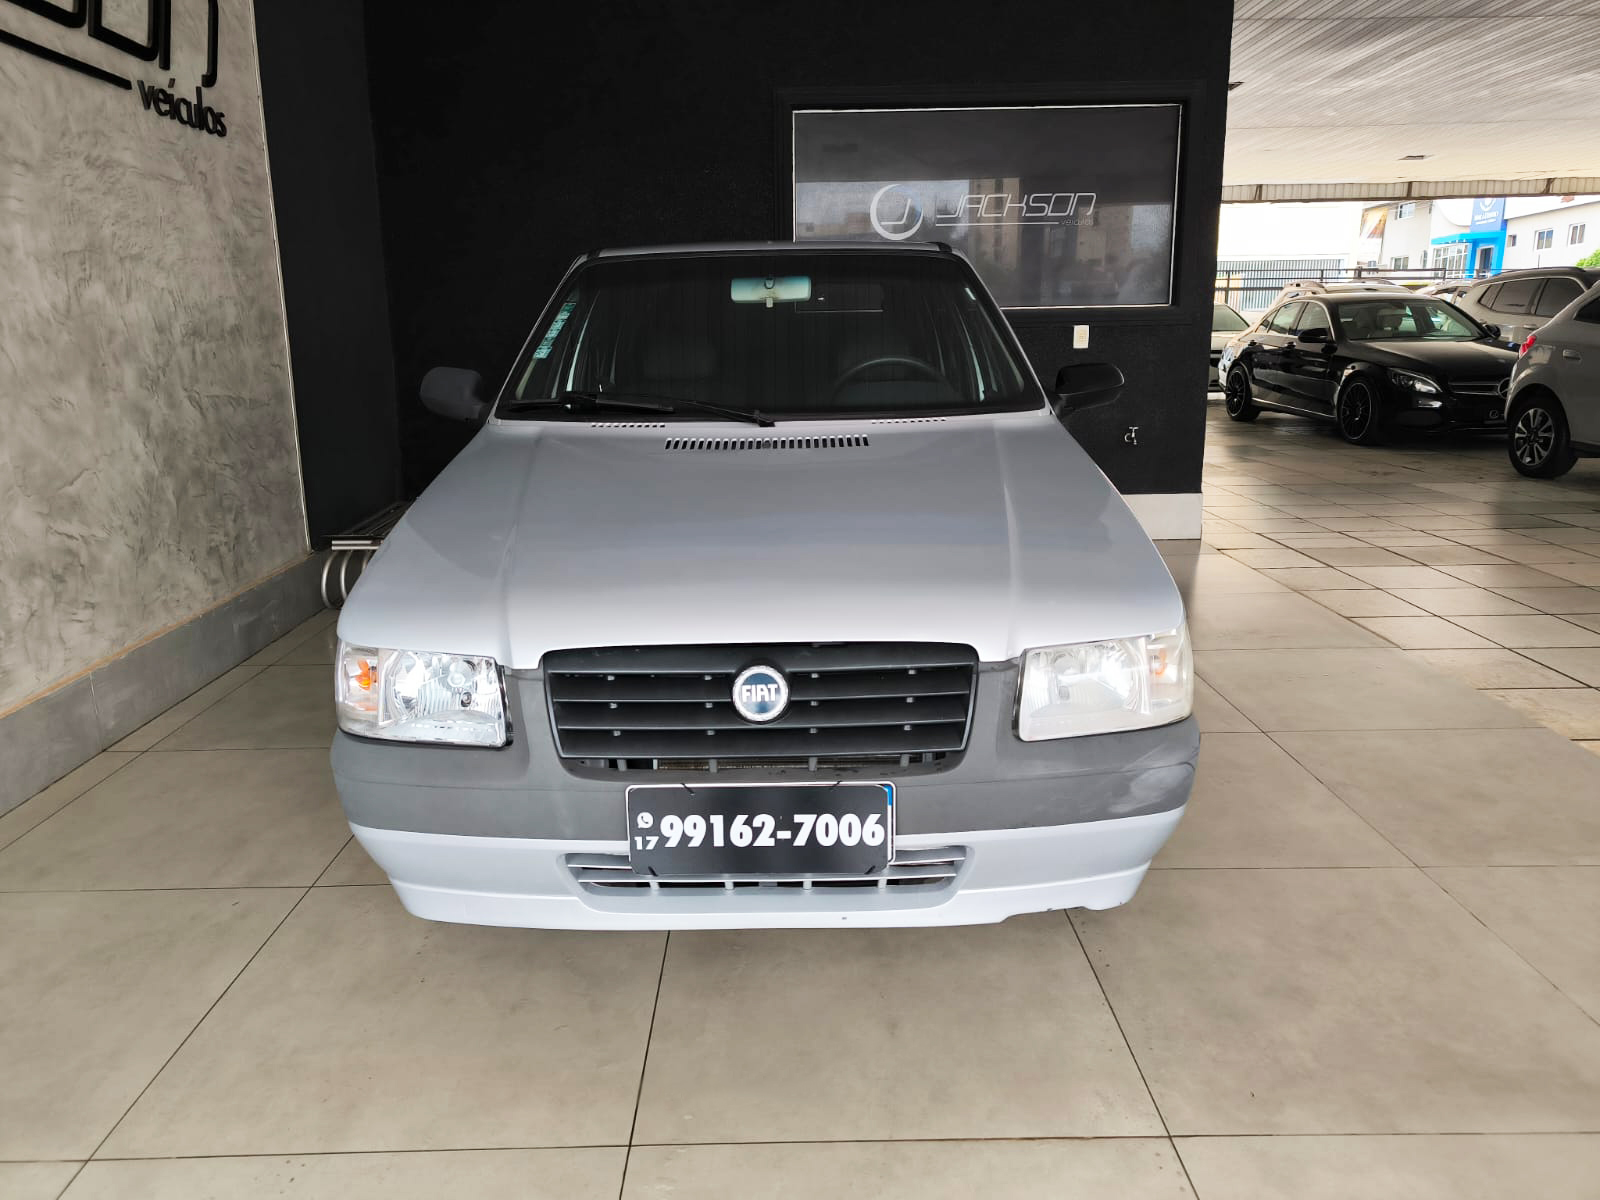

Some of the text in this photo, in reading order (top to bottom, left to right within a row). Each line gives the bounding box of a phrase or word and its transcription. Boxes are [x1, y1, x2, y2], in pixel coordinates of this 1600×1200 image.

[137, 78, 227, 137] veículos
[936, 192, 1097, 218] JACKSON
[741, 683, 778, 702] FIAT
[634, 836, 659, 850] 17
[660, 813, 885, 848] 99162-7006
